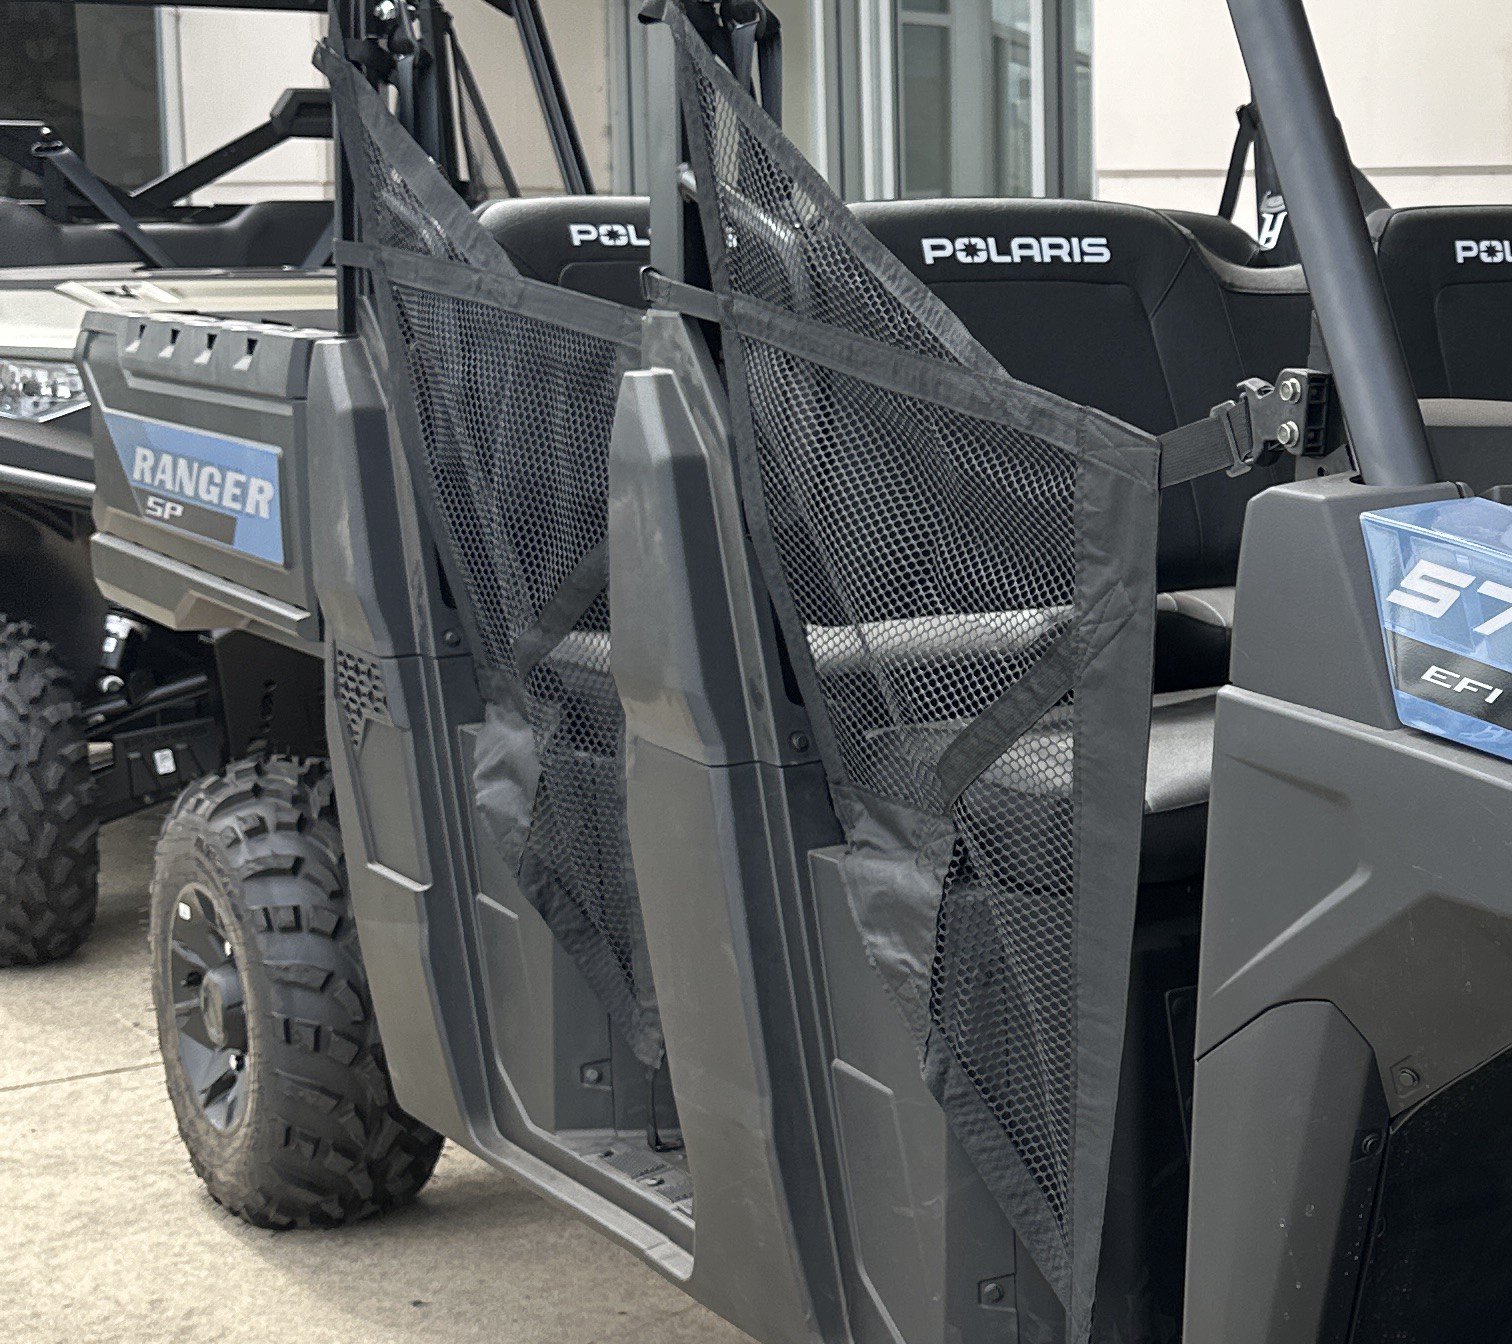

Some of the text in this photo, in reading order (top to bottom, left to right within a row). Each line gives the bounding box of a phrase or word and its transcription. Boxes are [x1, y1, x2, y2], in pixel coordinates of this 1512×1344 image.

[920, 234, 1112, 265] POLARIS
[133, 446, 274, 519] RANGER
[145, 495, 184, 520] SP
[1420, 664, 1505, 705] EFI
